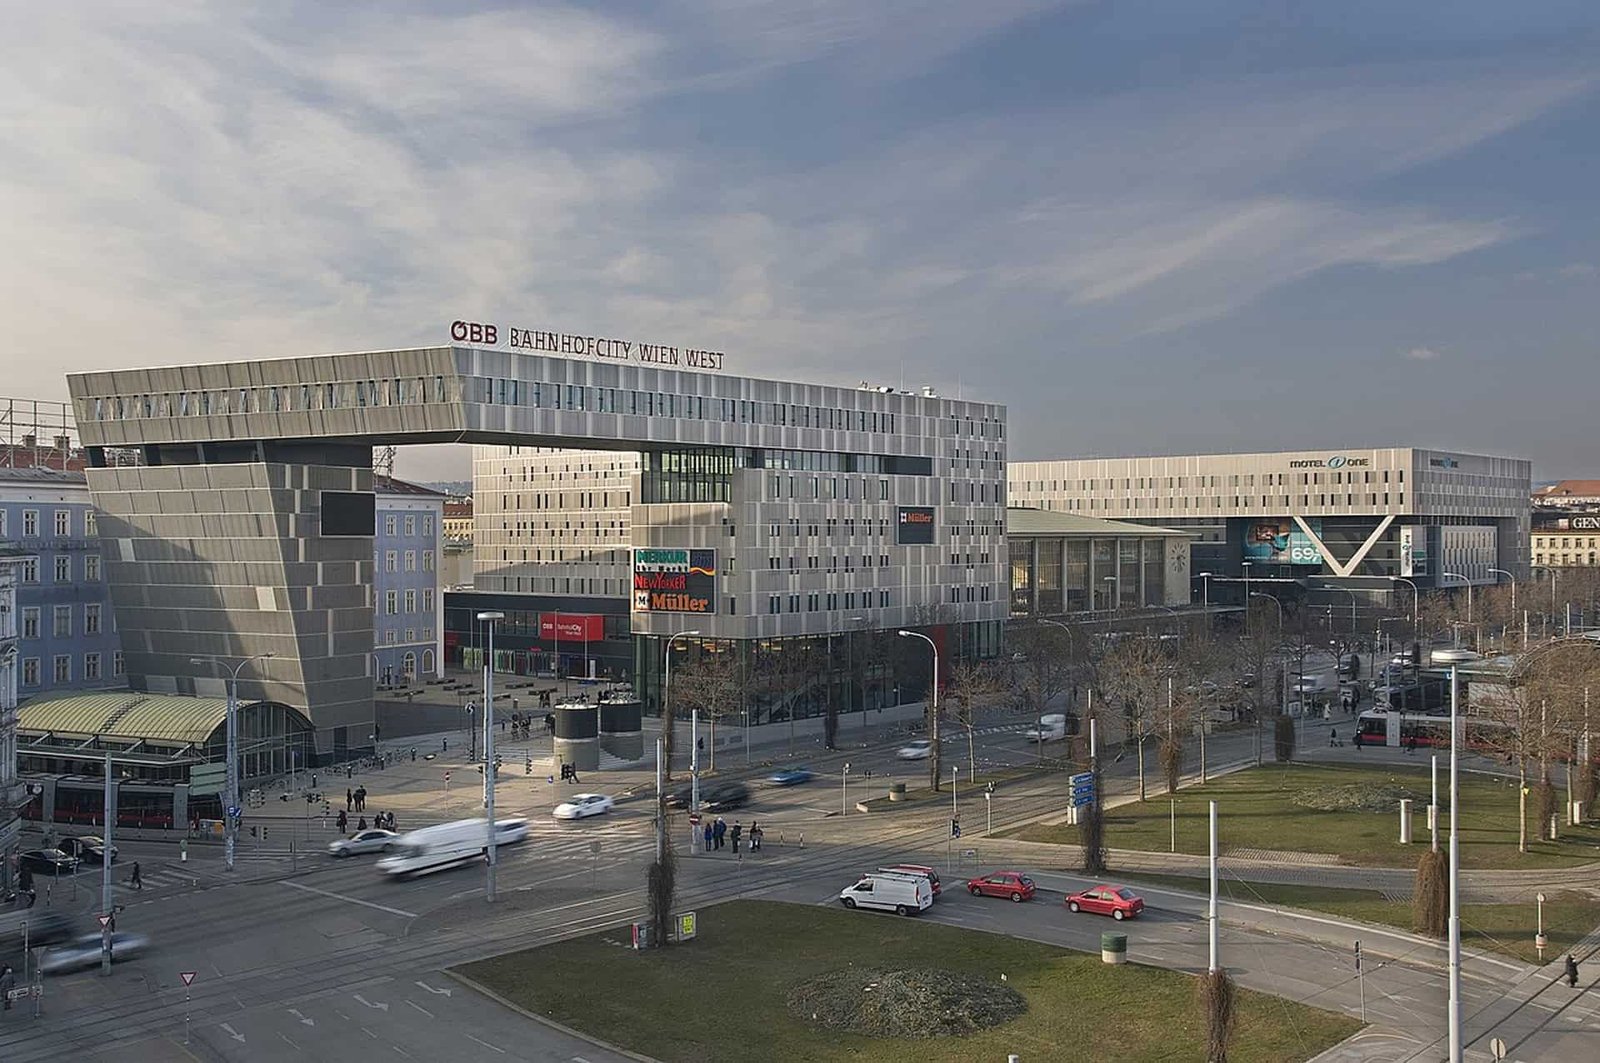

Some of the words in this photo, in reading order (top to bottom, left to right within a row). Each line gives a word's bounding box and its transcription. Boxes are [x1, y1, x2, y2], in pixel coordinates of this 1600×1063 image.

[510, 327, 632, 360] BAHNHOFCITY
[639, 343, 679, 366] WIEN
[686, 350, 724, 370] WEST
[1573, 517, 1600, 529] GEN
[653, 593, 708, 611] Müller
